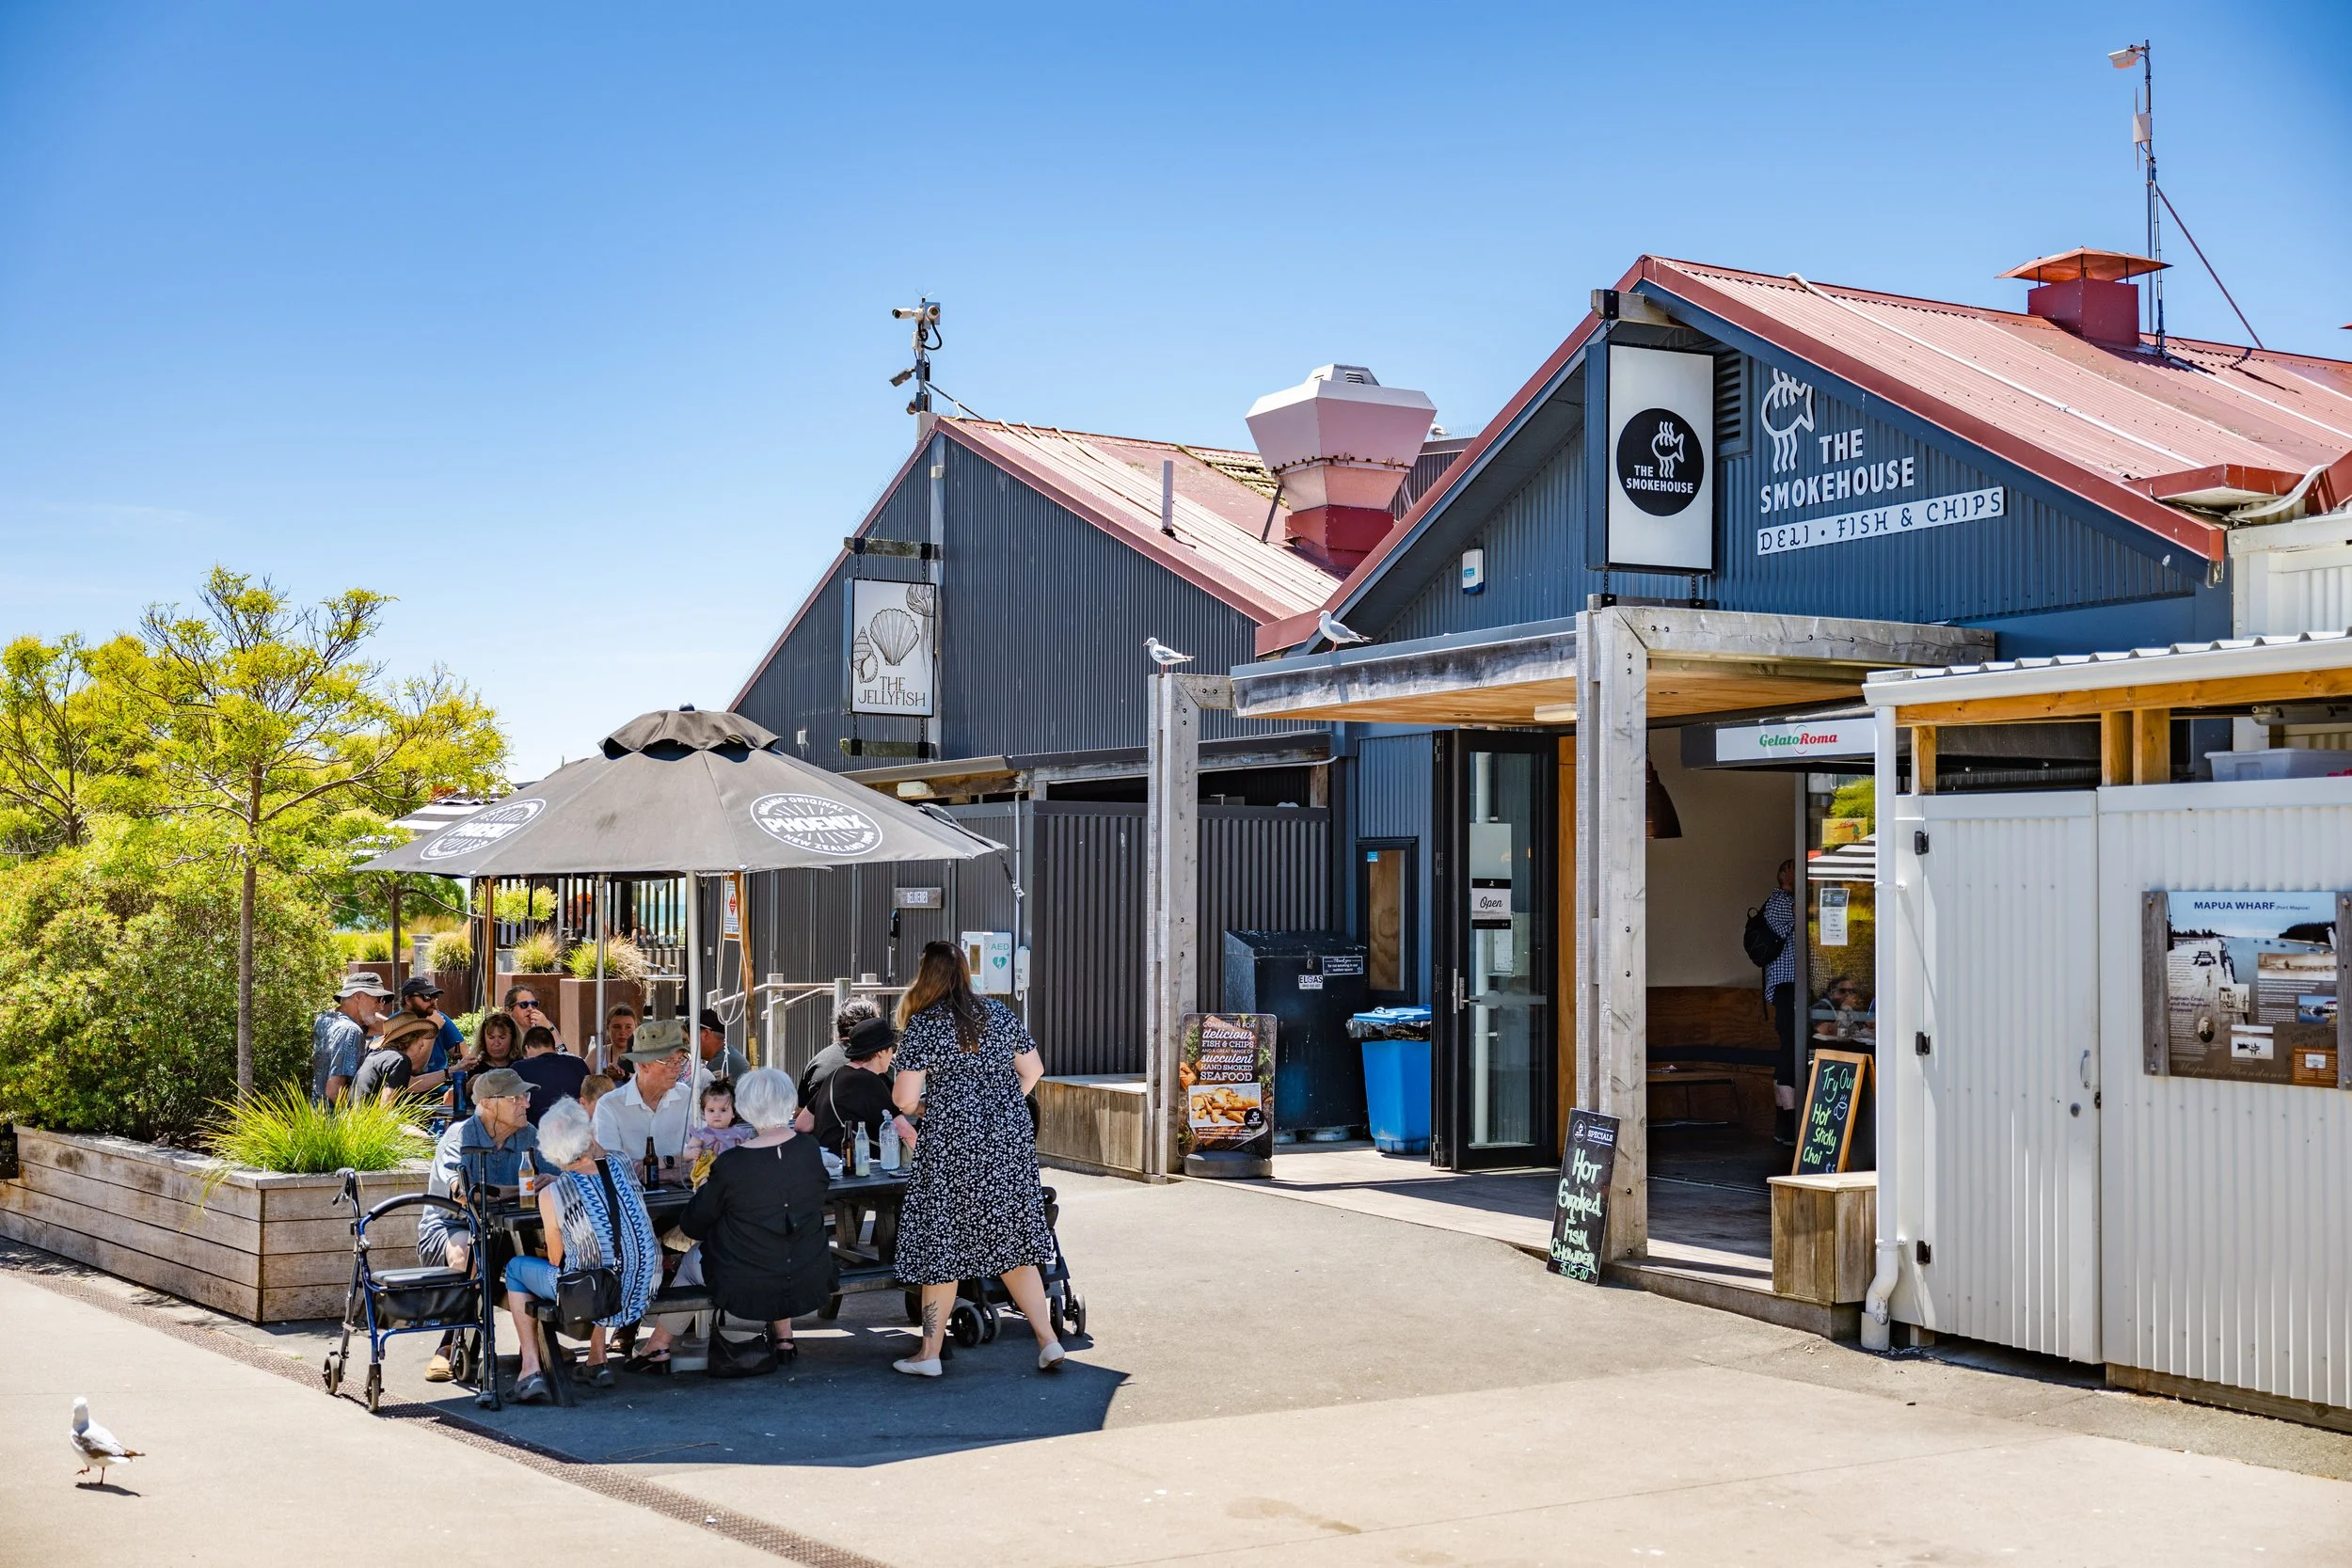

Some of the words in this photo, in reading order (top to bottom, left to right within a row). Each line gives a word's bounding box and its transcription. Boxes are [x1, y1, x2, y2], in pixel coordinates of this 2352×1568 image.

[1819, 428, 1864, 464] THE
[1633, 465, 1654, 477] THE
[1626, 478, 1693, 494] SMOKEHOUSE
[1760, 456, 1915, 514] SMOKEHOUSE
[1760, 525, 1809, 551] DELI
[1836, 511, 1888, 538] FISH
[1900, 507, 1913, 528] &
[1927, 492, 2001, 522] CHIPS
[879, 675, 906, 691] THE
[858, 689, 926, 706] JELLYFISH
[788, 797, 844, 813] ORIGINAL
[760, 815, 871, 832] PHOENIX
[784, 833, 811, 847] NEW
[814, 842, 866, 852] ZEALAND
[1479, 896, 1503, 910] Open
[2194, 901, 2233, 910] MAPUA
[2235, 901, 2276, 910] WHARF
[1299, 975, 1323, 984] ELGAS
[1202, 1028, 1254, 1039] delicious
[1202, 1039, 1221, 1048] FISH
[1229, 1040, 1254, 1049] CHIPS
[1200, 1053, 1254, 1064] succulent
[1200, 1071, 1253, 1082] SEAFOOD
[1823, 1065, 1839, 1102] Try
[1840, 1068, 1855, 1090] Our
[1812, 1102, 1832, 1126] Hot
[1587, 1130, 1613, 1142] SPECIALS
[1812, 1127, 1837, 1154] Sticky
[1803, 1146, 1823, 1165] Chai
